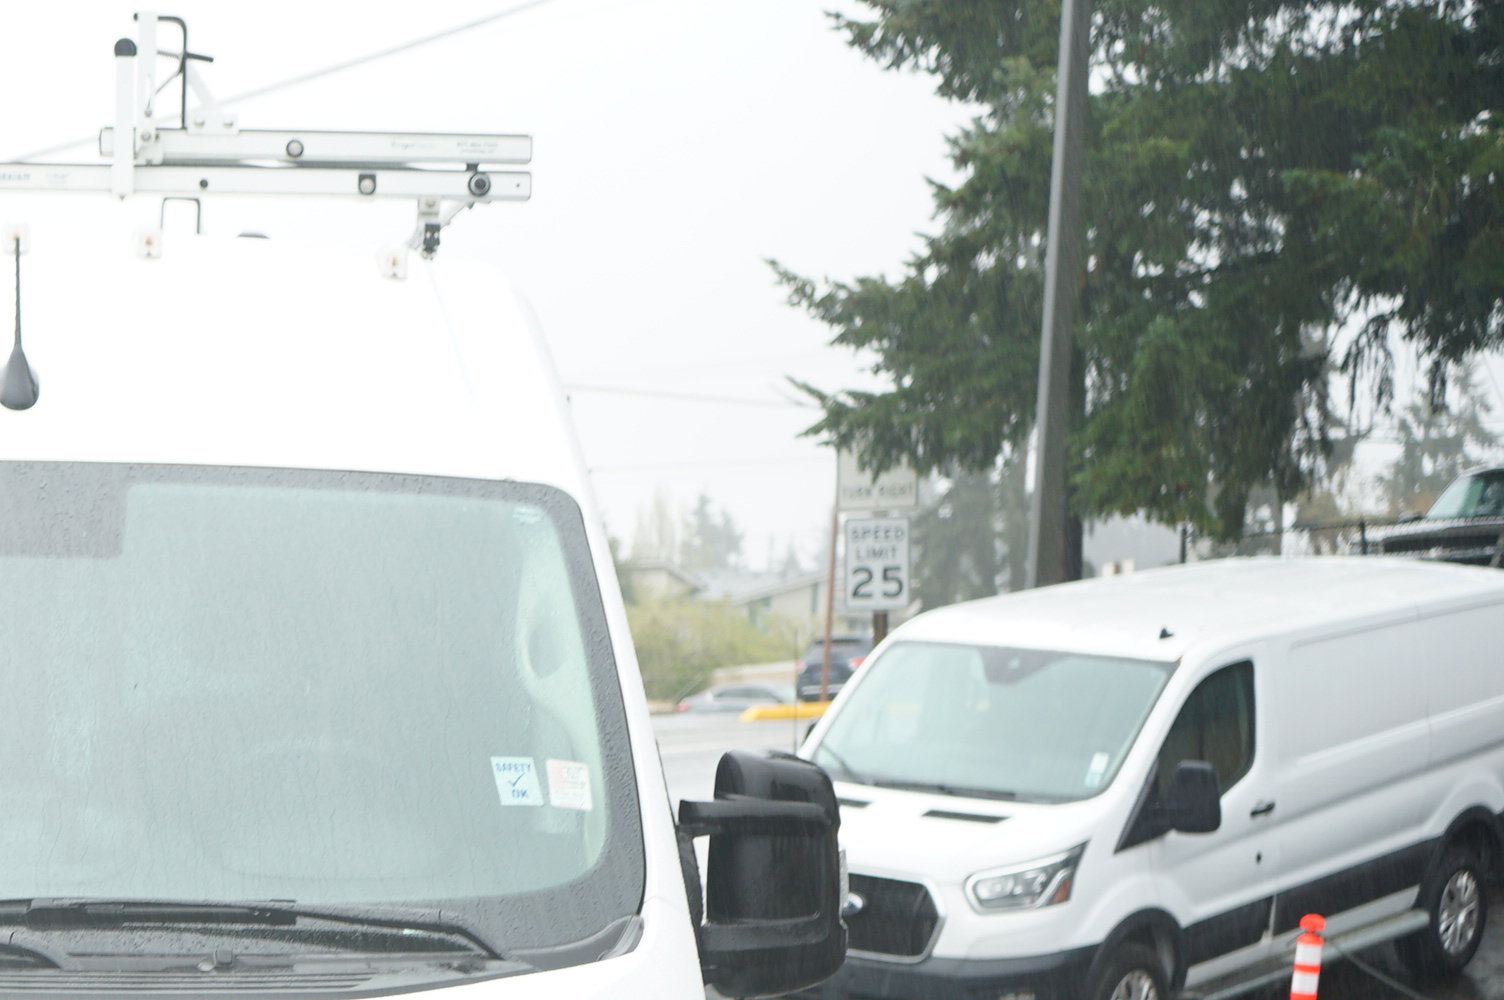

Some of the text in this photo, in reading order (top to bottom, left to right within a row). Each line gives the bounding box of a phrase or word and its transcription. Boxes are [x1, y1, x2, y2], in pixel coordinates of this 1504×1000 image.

[852, 525, 905, 542] SPEED
[856, 546, 897, 561] LIMIT
[852, 566, 904, 598] 25
